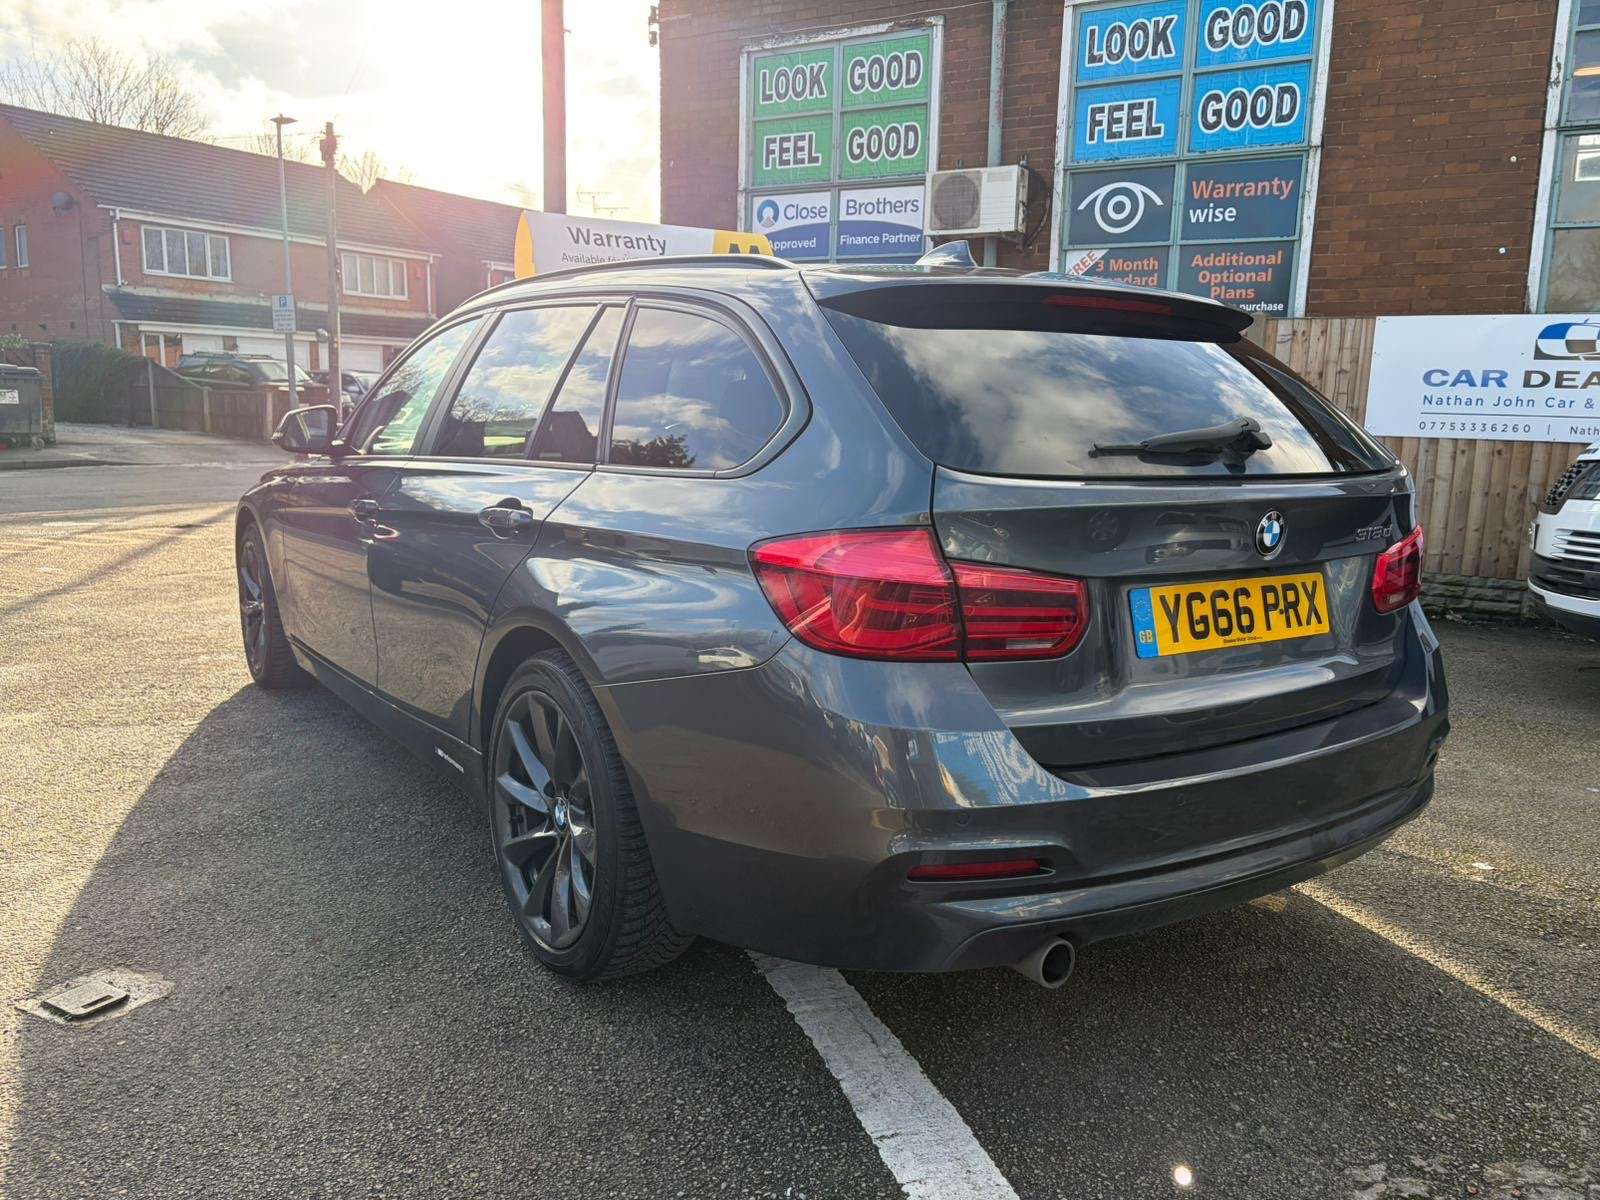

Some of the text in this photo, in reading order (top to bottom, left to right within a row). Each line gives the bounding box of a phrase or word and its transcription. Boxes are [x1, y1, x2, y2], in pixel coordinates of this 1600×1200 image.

[1085, 0, 1309, 67] LOOK GOOD
[759, 50, 923, 104] LOOK GOOD
[1086, 82, 1301, 144] FEEL GOOD
[763, 122, 921, 170] FEEL GOOD
[1192, 176, 1294, 201] Warranty
[783, 197, 919, 221] Close Brothers
[1189, 203, 1238, 224] wise
[566, 225, 667, 256] Warranty
[768, 236, 816, 252] Approved
[840, 236, 880, 246] Finance
[882, 233, 922, 245] Partner
[561, 252, 606, 264] Available
[1096, 256, 1159, 273] 3 Month
[1191, 251, 1283, 268] Additional
[1198, 268, 1273, 286] Optional
[1210, 285, 1256, 299] Plans
[1239, 301, 1284, 312] purchase
[1422, 368, 1509, 388] CAR
[1422, 395, 1594, 409] Nathan John Car &
[1419, 421, 1600, 436] 07753336260 Nath
[1159, 580, 1323, 643] YG66 PRX
